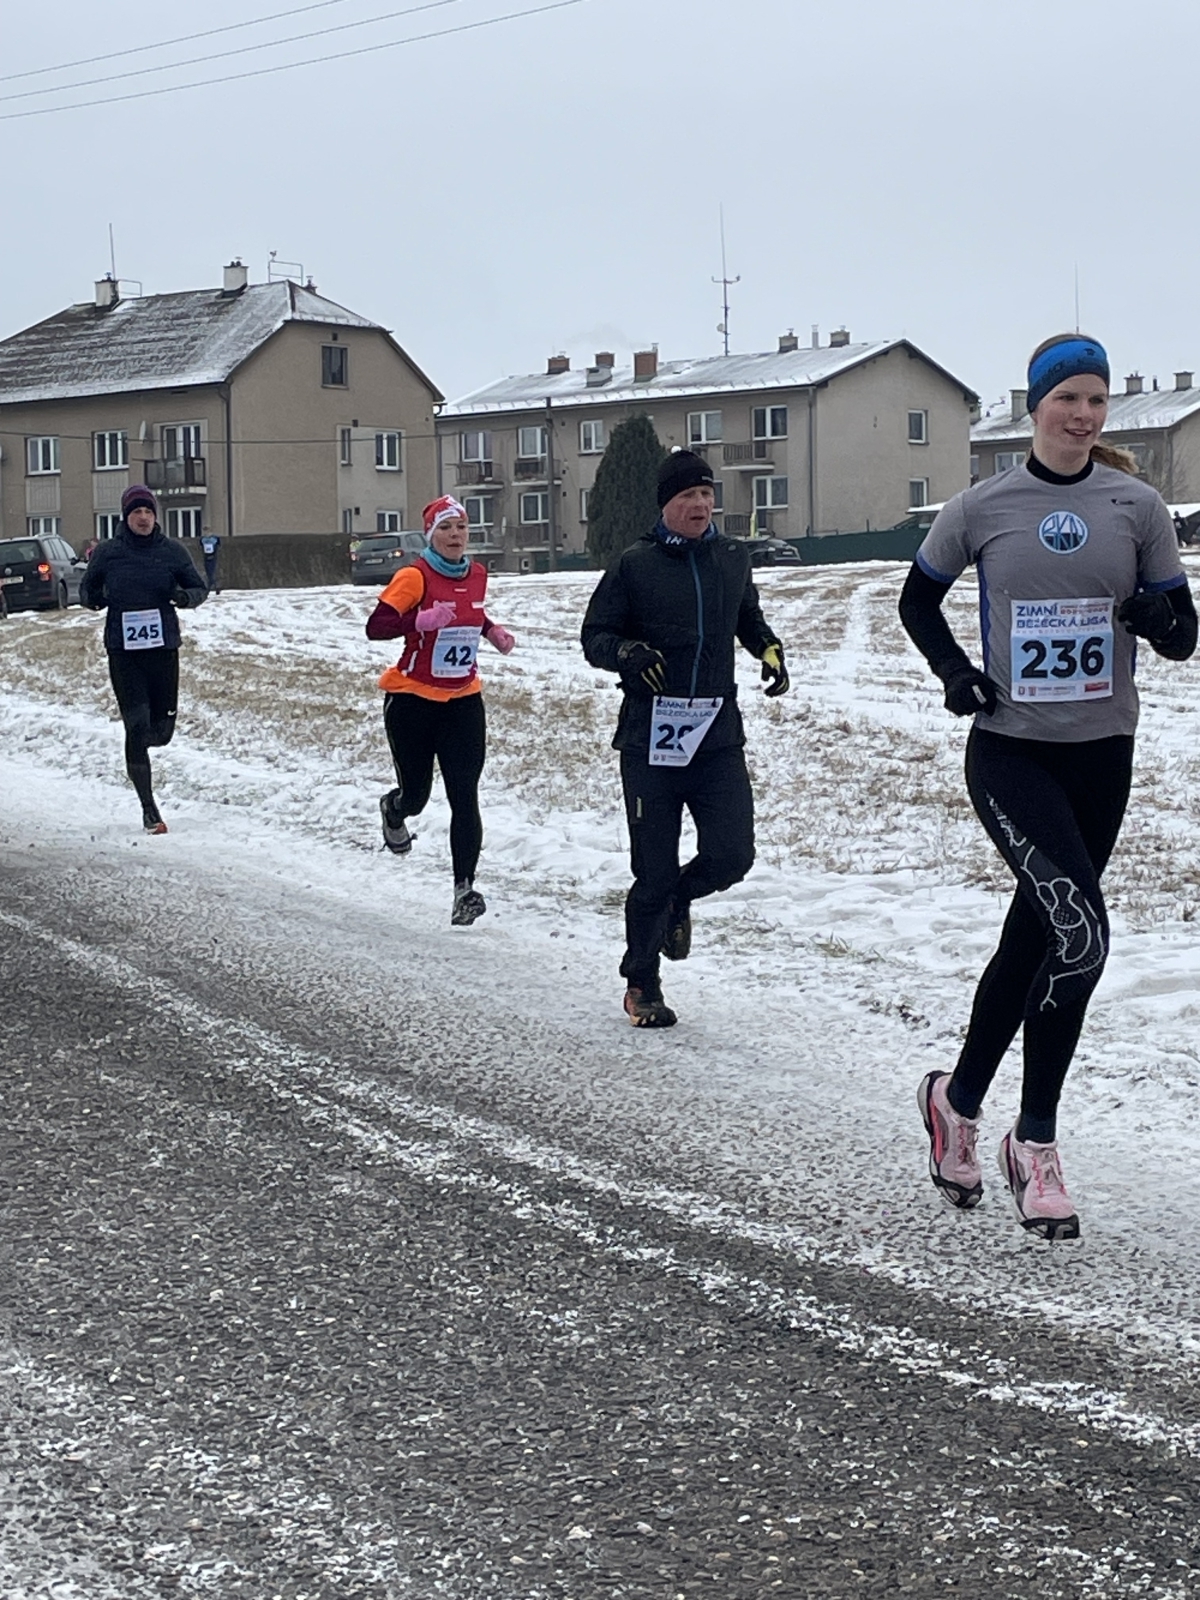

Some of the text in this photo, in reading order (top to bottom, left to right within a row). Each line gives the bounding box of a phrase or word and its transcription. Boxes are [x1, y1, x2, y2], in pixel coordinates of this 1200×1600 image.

[127, 624, 159, 641] 245
[443, 645, 473, 667] 42
[1020, 636, 1105, 679] 236
